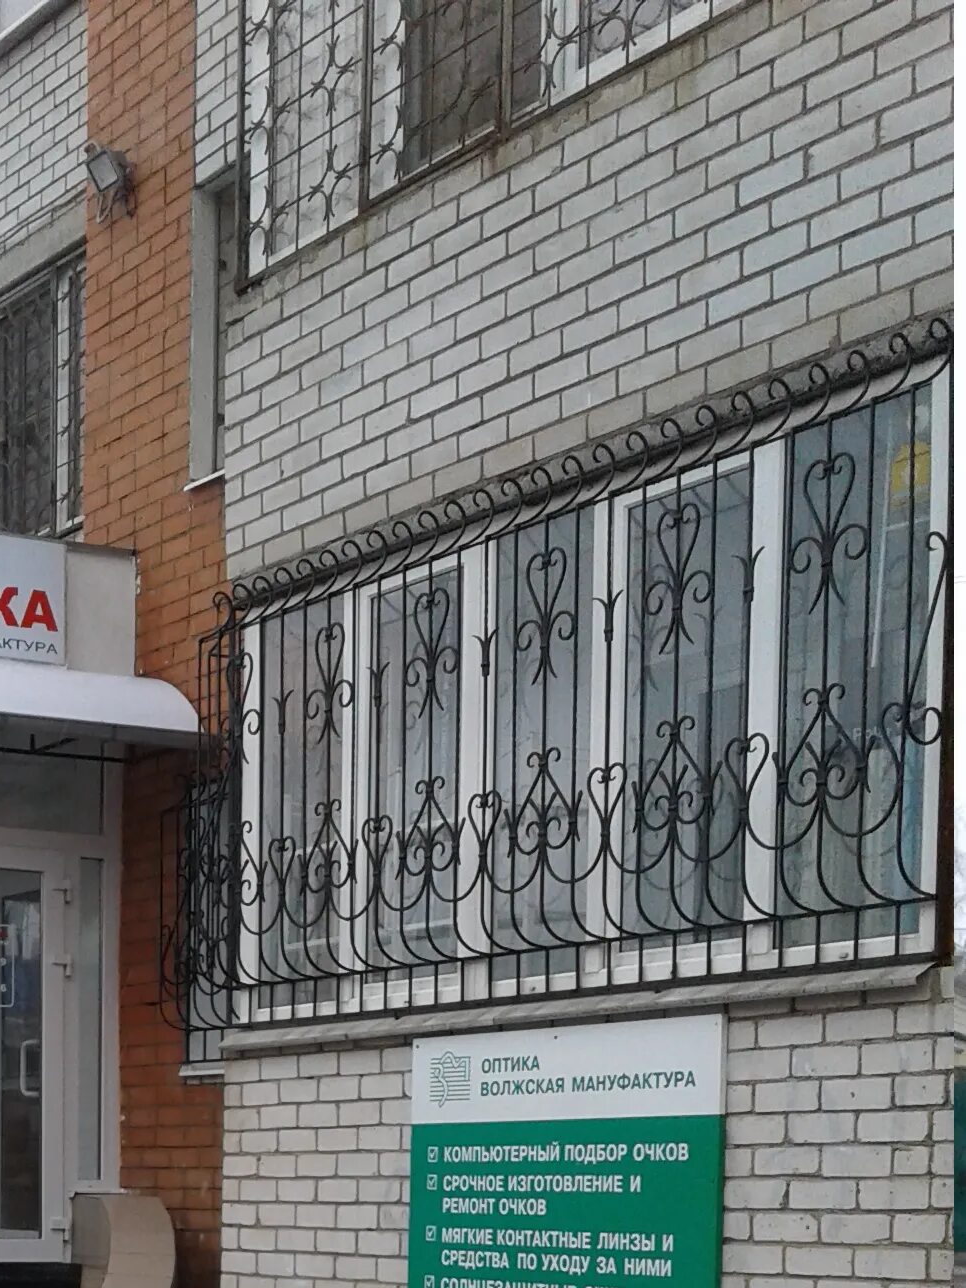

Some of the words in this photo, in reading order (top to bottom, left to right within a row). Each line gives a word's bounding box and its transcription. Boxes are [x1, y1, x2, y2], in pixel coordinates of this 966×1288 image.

[481, 1056, 540, 1074] ОПТИКА
[480, 1077, 565, 1097] ВОЛЖСКАЯ
[571, 1070, 696, 1092] МАНУФАКТУРА
[443, 1141, 560, 1163] КОМПЬЮТЕРНЫЙ
[564, 1144, 627, 1165] ПОДБОР
[633, 1143, 689, 1162] ОЧКОВ
[443, 1175, 504, 1192] СРОЧНОЕ
[507, 1175, 623, 1193] ИЗГОТОВЛЕНИЕ
[629, 1175, 641, 1193] И
[442, 1198, 495, 1215] РЕМОНТ
[499, 1199, 547, 1216] ОЧКОВ
[441, 1228, 493, 1245] МЯГКИЕ
[497, 1229, 591, 1249] КОНТАКТНЫЕ
[597, 1233, 655, 1252] ЛИНЗЫ
[662, 1234, 674, 1252] И
[441, 1250, 509, 1270] СРЕДСТВА
[517, 1253, 537, 1270] ПО
[541, 1254, 590, 1276] УХОДУ
[596, 1256, 616, 1274] ЗА
[624, 1258, 672, 1277] НИМИ
